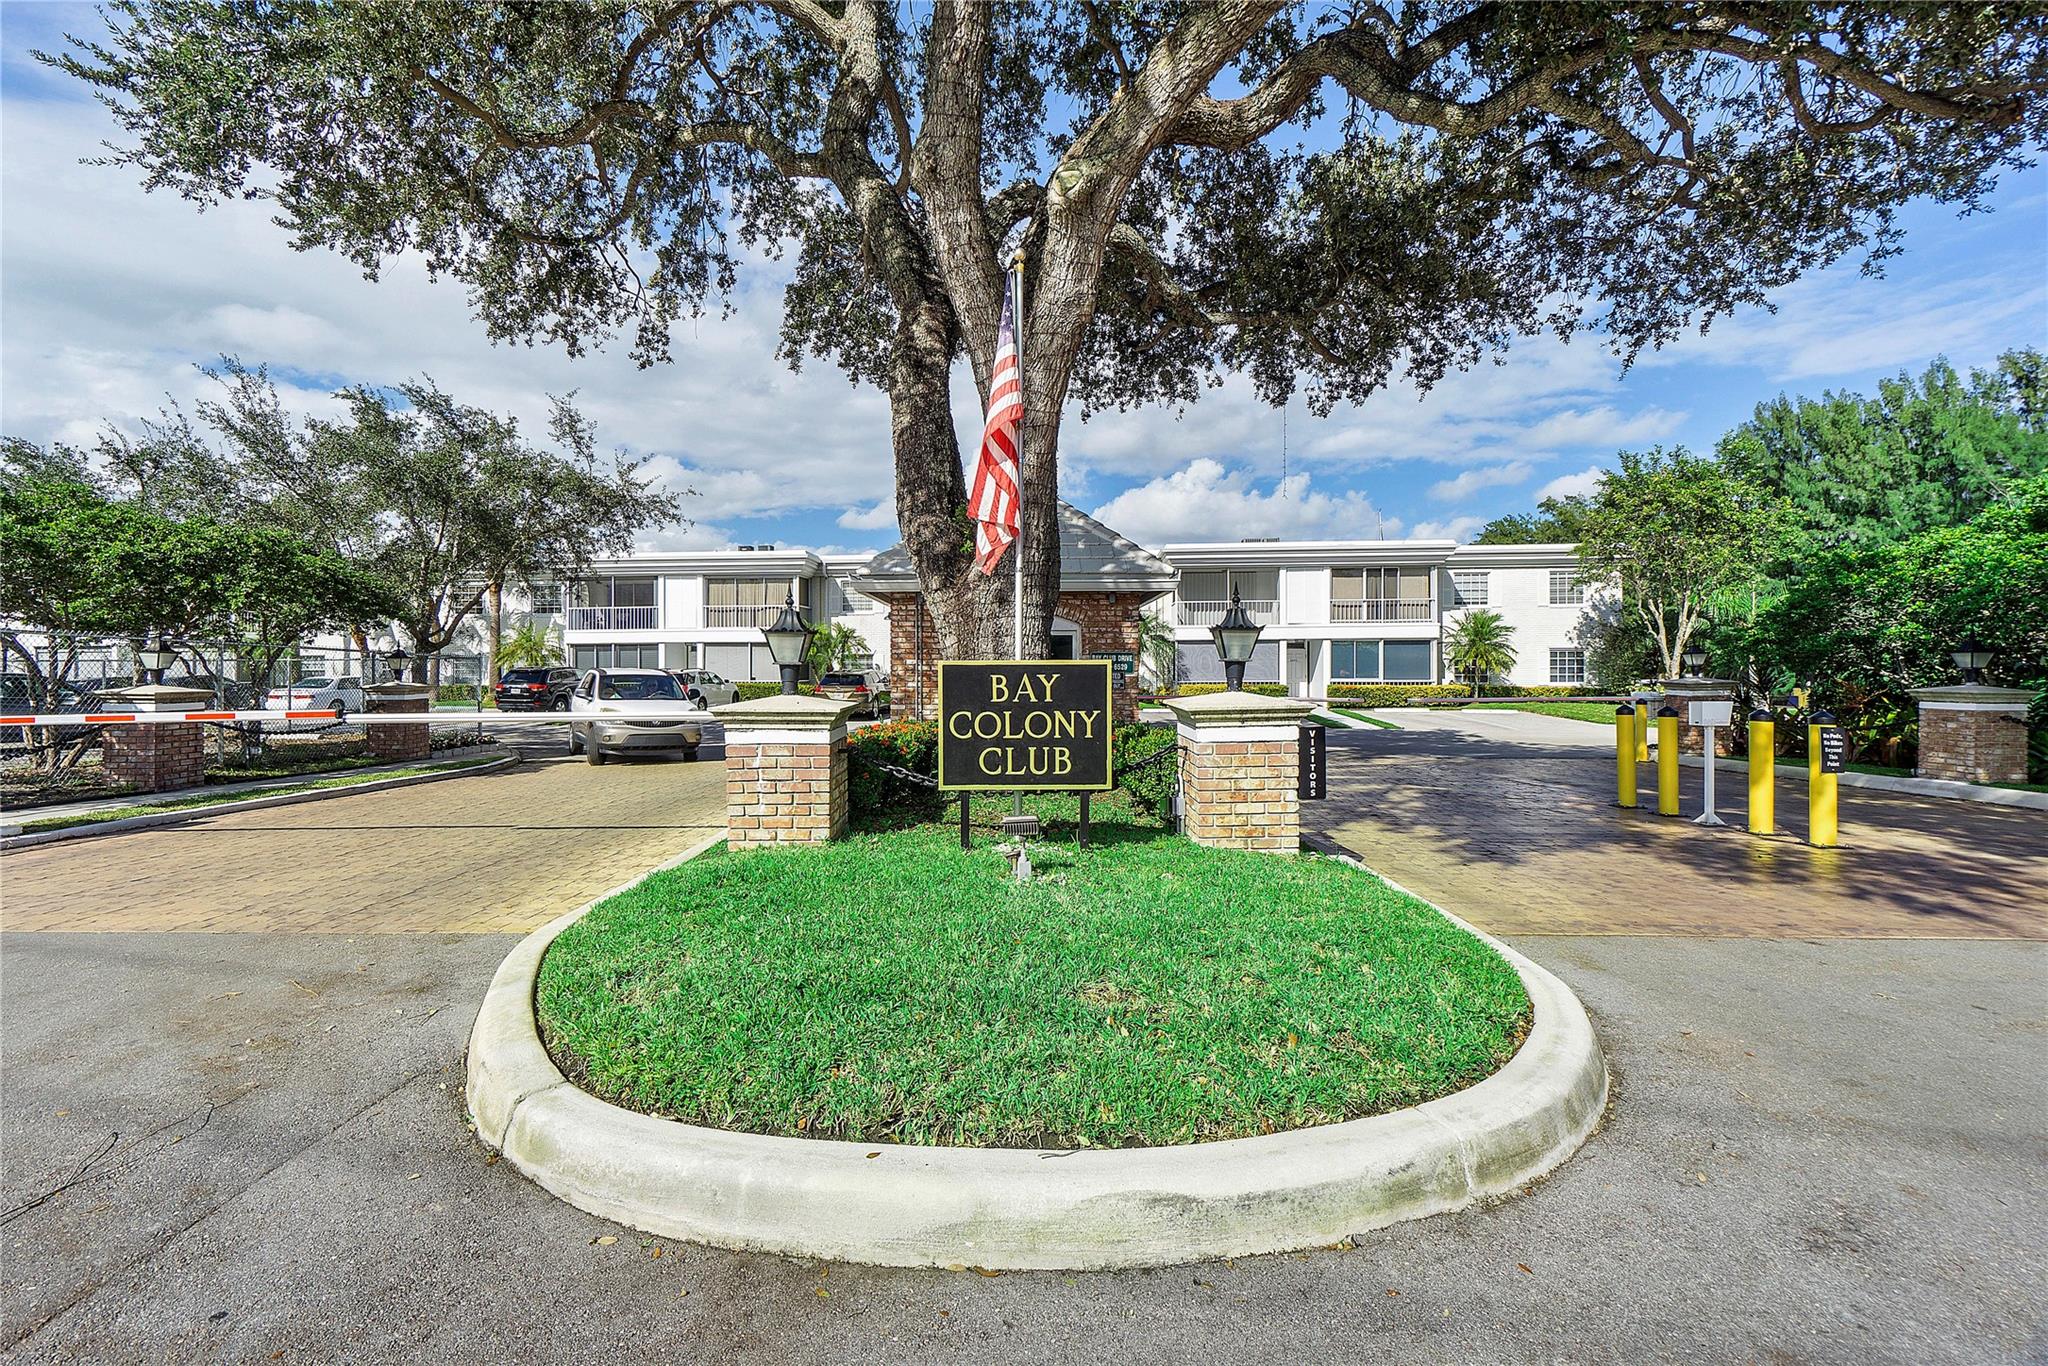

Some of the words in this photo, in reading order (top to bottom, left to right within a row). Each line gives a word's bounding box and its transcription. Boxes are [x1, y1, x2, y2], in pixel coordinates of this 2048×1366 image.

[990, 673, 1061, 703] BAY
[949, 710, 1101, 740] COLONY
[978, 746, 1072, 775] CLUB
[1309, 730, 1317, 797] VISITORS
